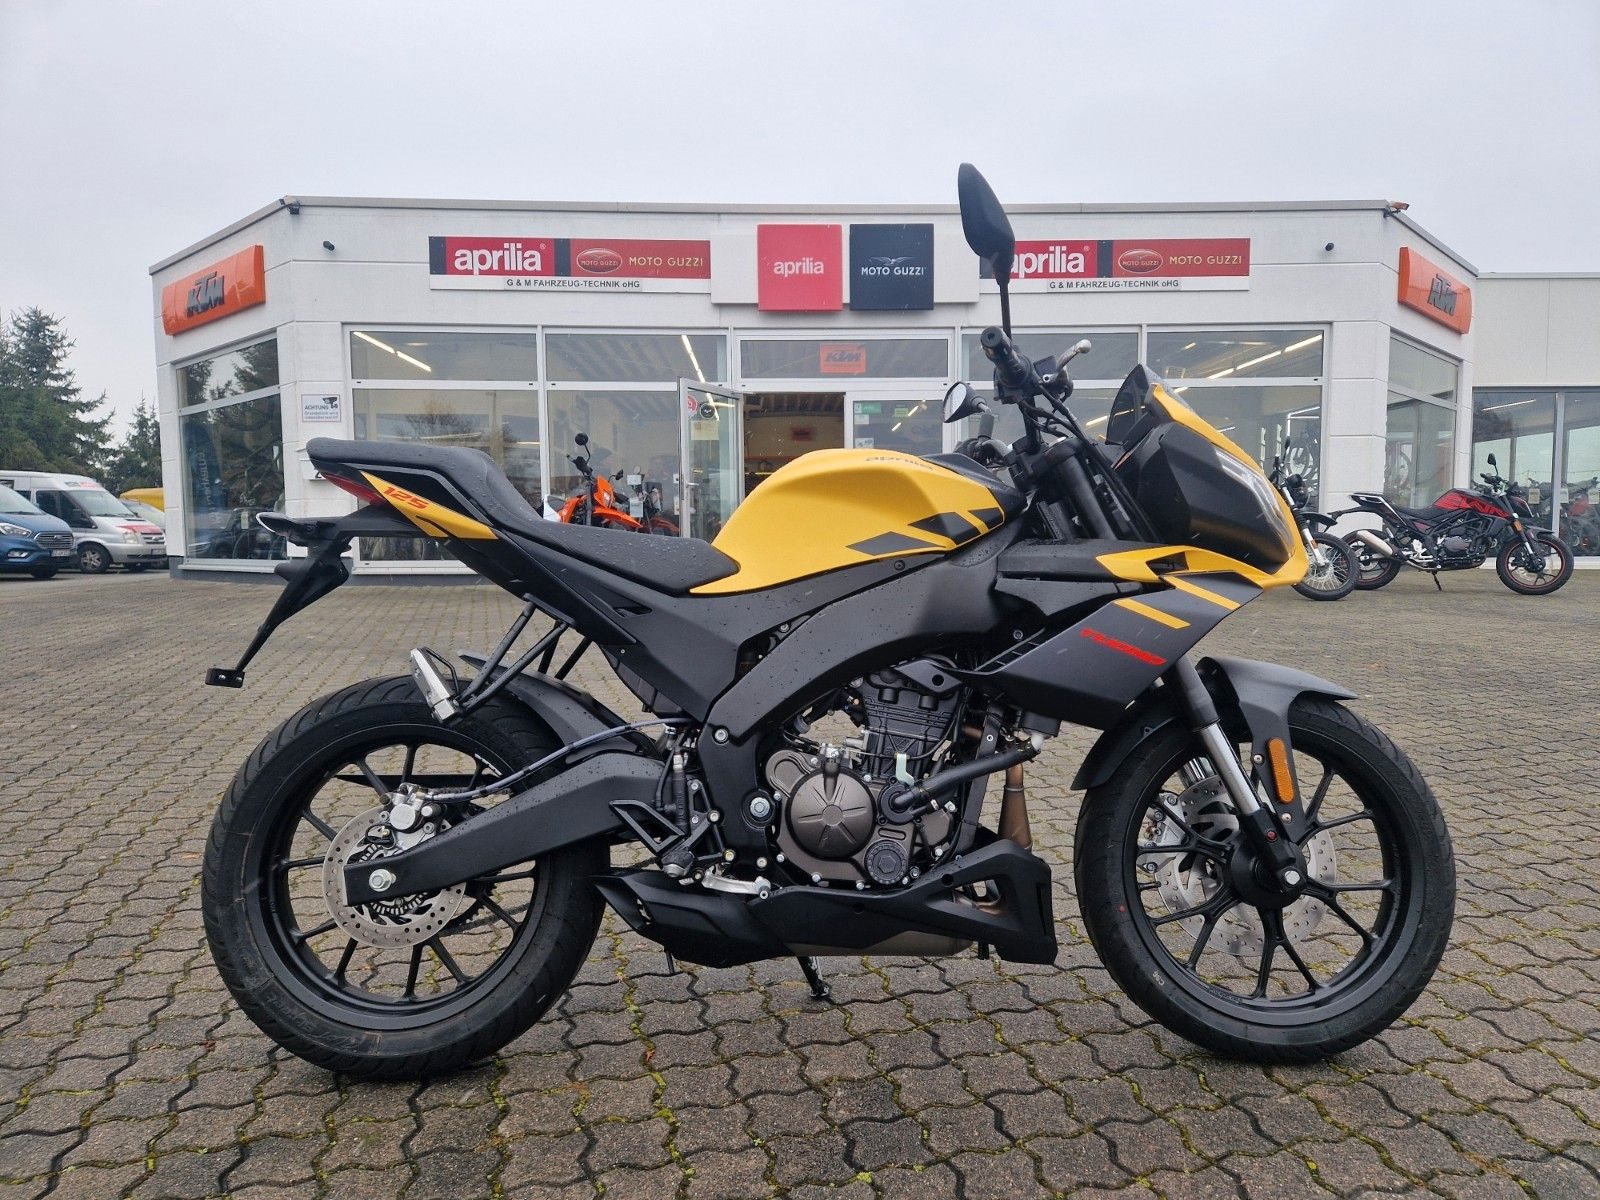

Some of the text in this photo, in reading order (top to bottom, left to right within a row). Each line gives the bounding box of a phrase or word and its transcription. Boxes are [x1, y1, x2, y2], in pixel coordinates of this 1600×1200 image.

[454, 243, 542, 275] aprilia
[629, 257, 703, 267] MOTO GUZZI
[1169, 255, 1242, 265] MOTO GUZZI
[773, 257, 824, 277] aprilia
[861, 266, 924, 276] MOTO GUZZI
[506, 279, 640, 288] G & M FAHRZEUG-TECHNIK oHG
[1075, 280, 1159, 288] FAHRZEUG-TECHNIK
[186, 271, 225, 318] KTM
[1427, 273, 1457, 316] KTM
[383, 486, 429, 510] 125
